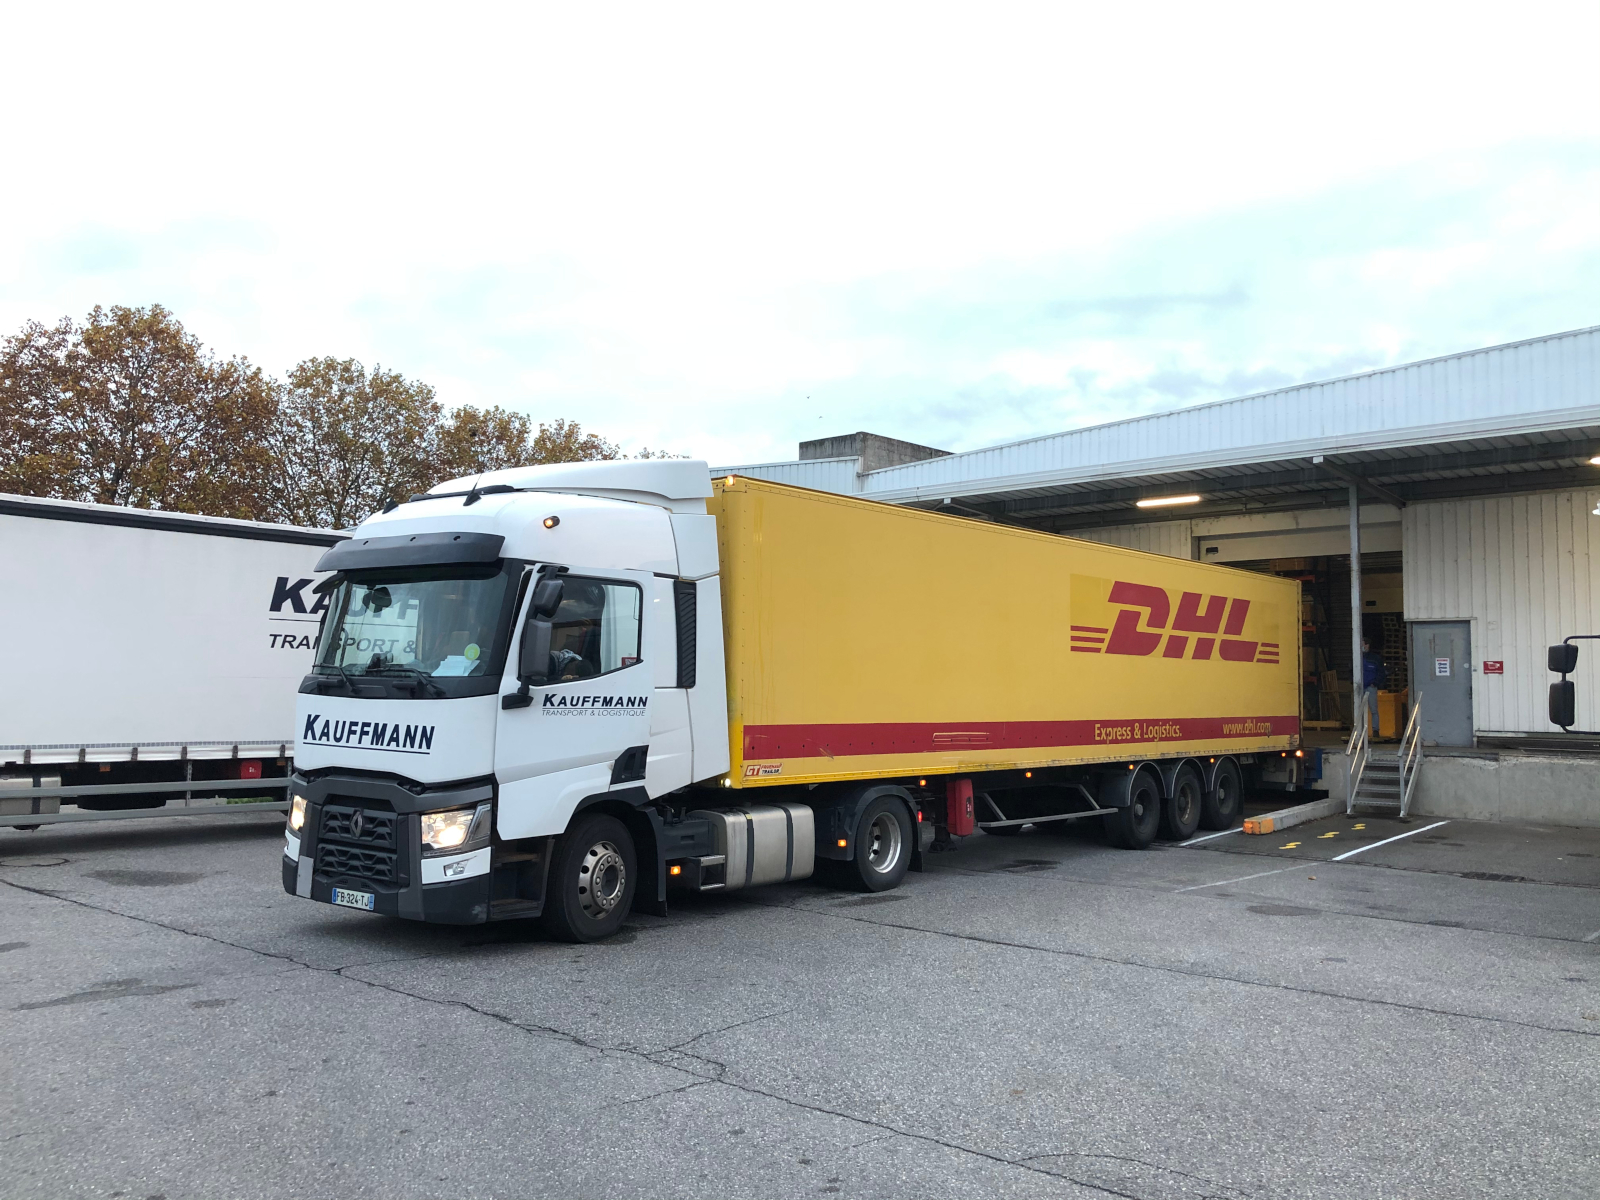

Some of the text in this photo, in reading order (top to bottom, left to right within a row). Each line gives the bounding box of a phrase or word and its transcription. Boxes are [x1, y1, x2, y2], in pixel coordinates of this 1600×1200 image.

[1104, 580, 1259, 662] DHL
[542, 693, 648, 707] KAUFFMANN
[542, 709, 588, 717] TRANSPORT
[598, 709, 646, 717] LOGISTIQUE
[303, 713, 435, 750] KAUFFMANN
[1094, 721, 1182, 741] Express & Logistics.
[1222, 719, 1271, 735] www.dhl.com
[745, 765, 760, 776] GT
